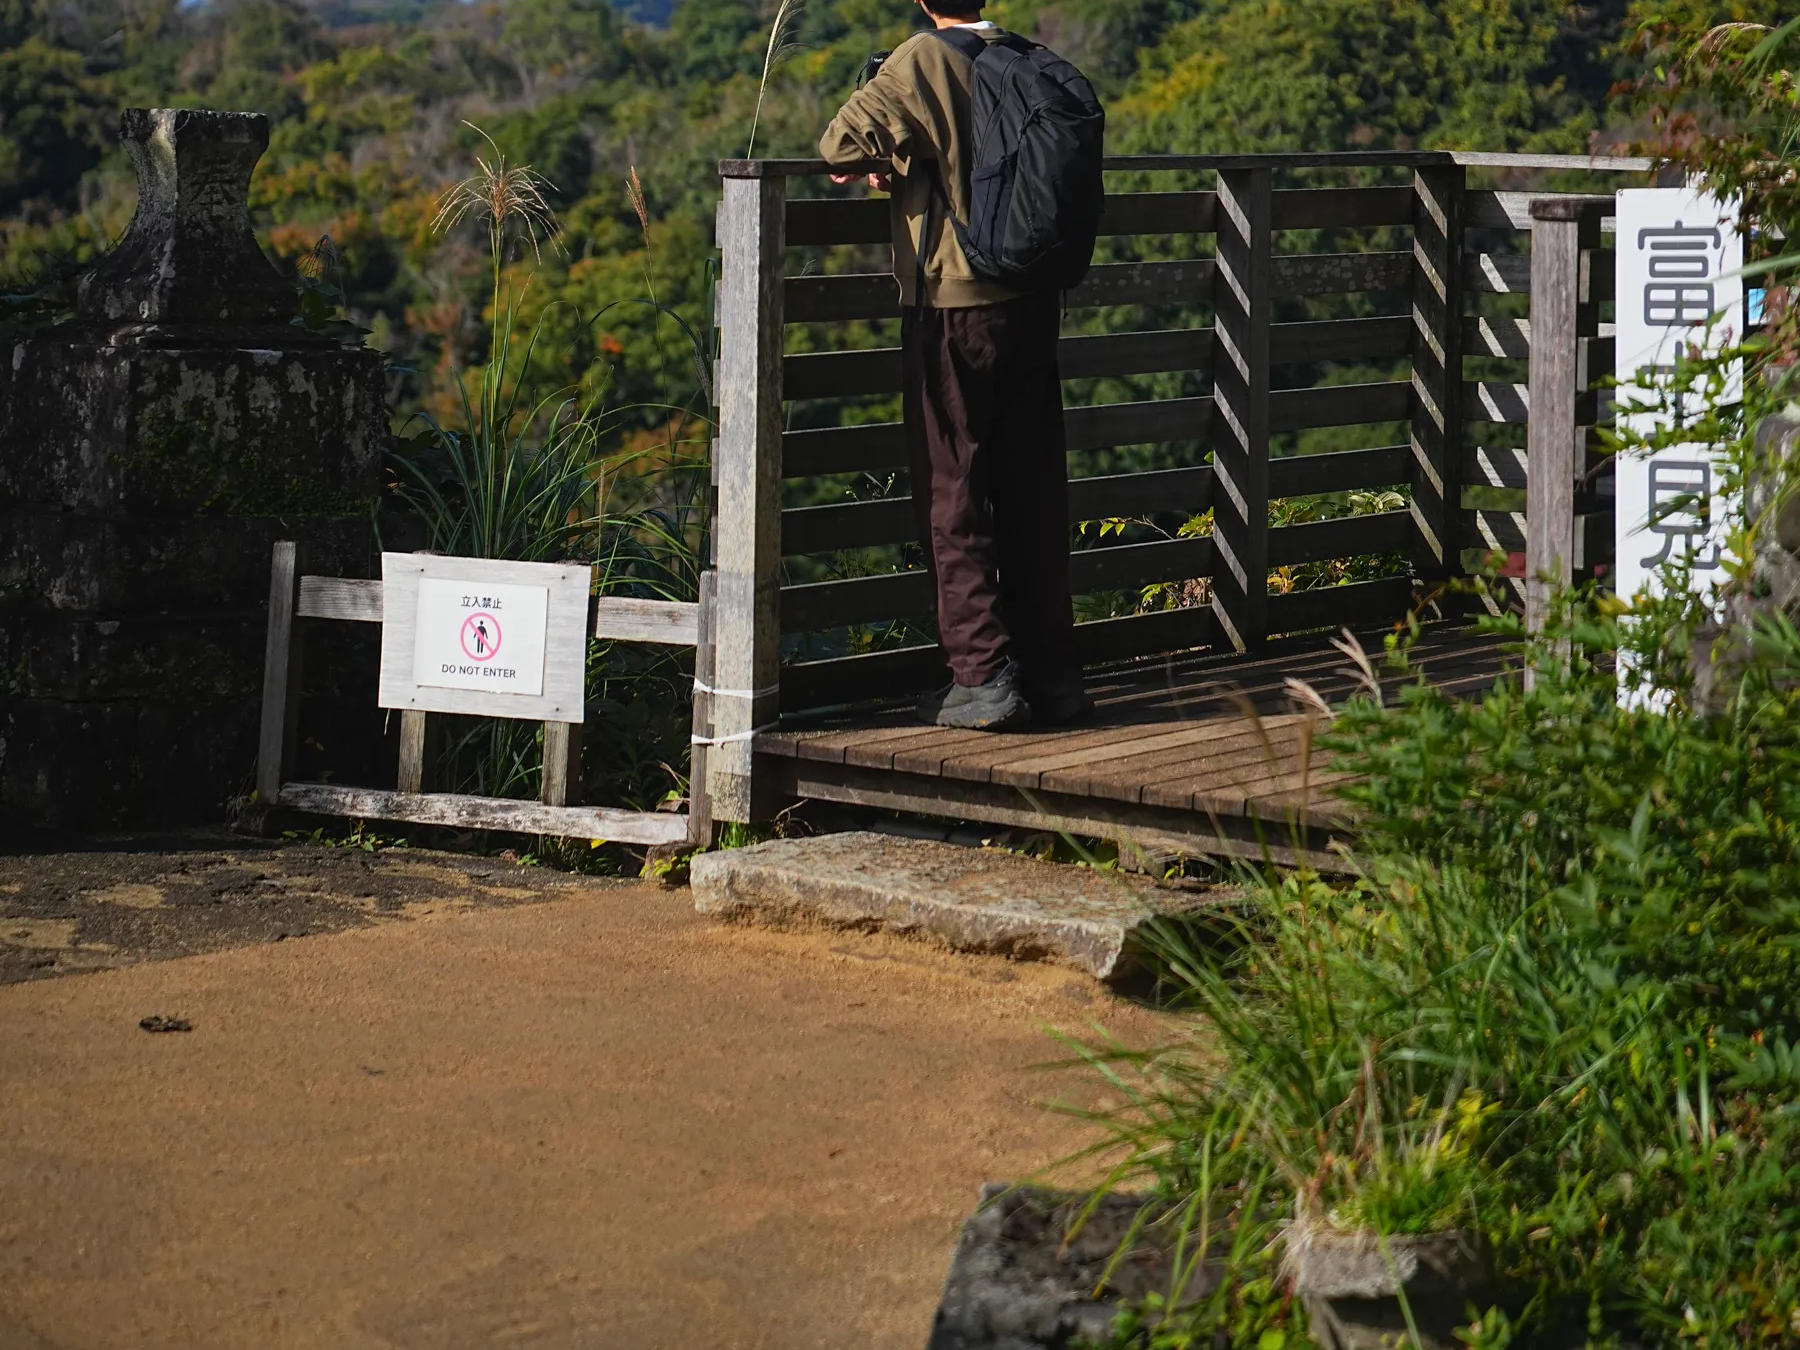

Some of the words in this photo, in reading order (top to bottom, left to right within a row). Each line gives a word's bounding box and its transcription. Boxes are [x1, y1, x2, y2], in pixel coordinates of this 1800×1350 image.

[461, 595, 502, 610] 立入禁止
[442, 664, 456, 674] DO
[459, 665, 480, 676] NOT
[483, 667, 516, 679] ENTER
